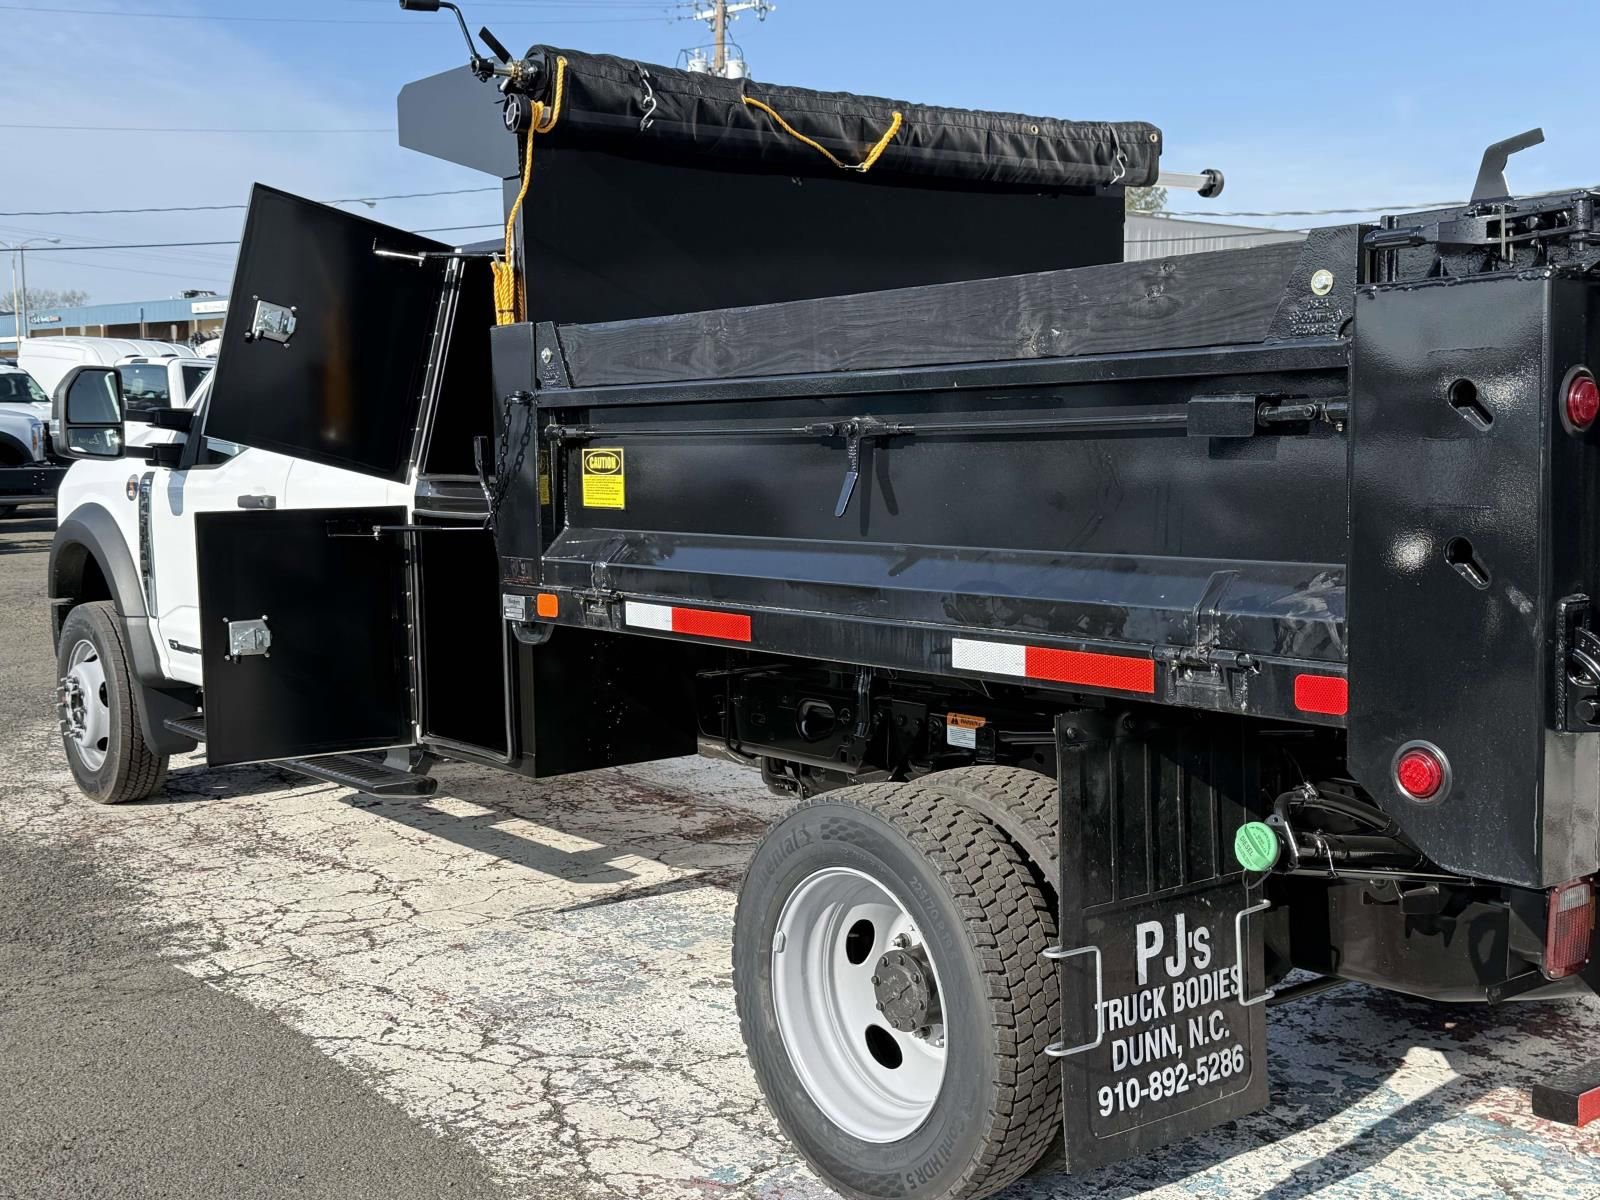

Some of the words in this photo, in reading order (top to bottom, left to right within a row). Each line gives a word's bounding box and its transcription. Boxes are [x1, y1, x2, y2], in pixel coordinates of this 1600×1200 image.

[589, 457, 617, 469] CAUTION
[1240, 835, 1253, 856] DIESEL
[1094, 985, 1167, 1033] TRUCK
[1172, 965, 1240, 1013] BODIES
[1111, 1024, 1183, 1072] DUNN,
[1188, 1010, 1230, 1048] N.C.
[1098, 1044, 1244, 1117] 910-892-5286
